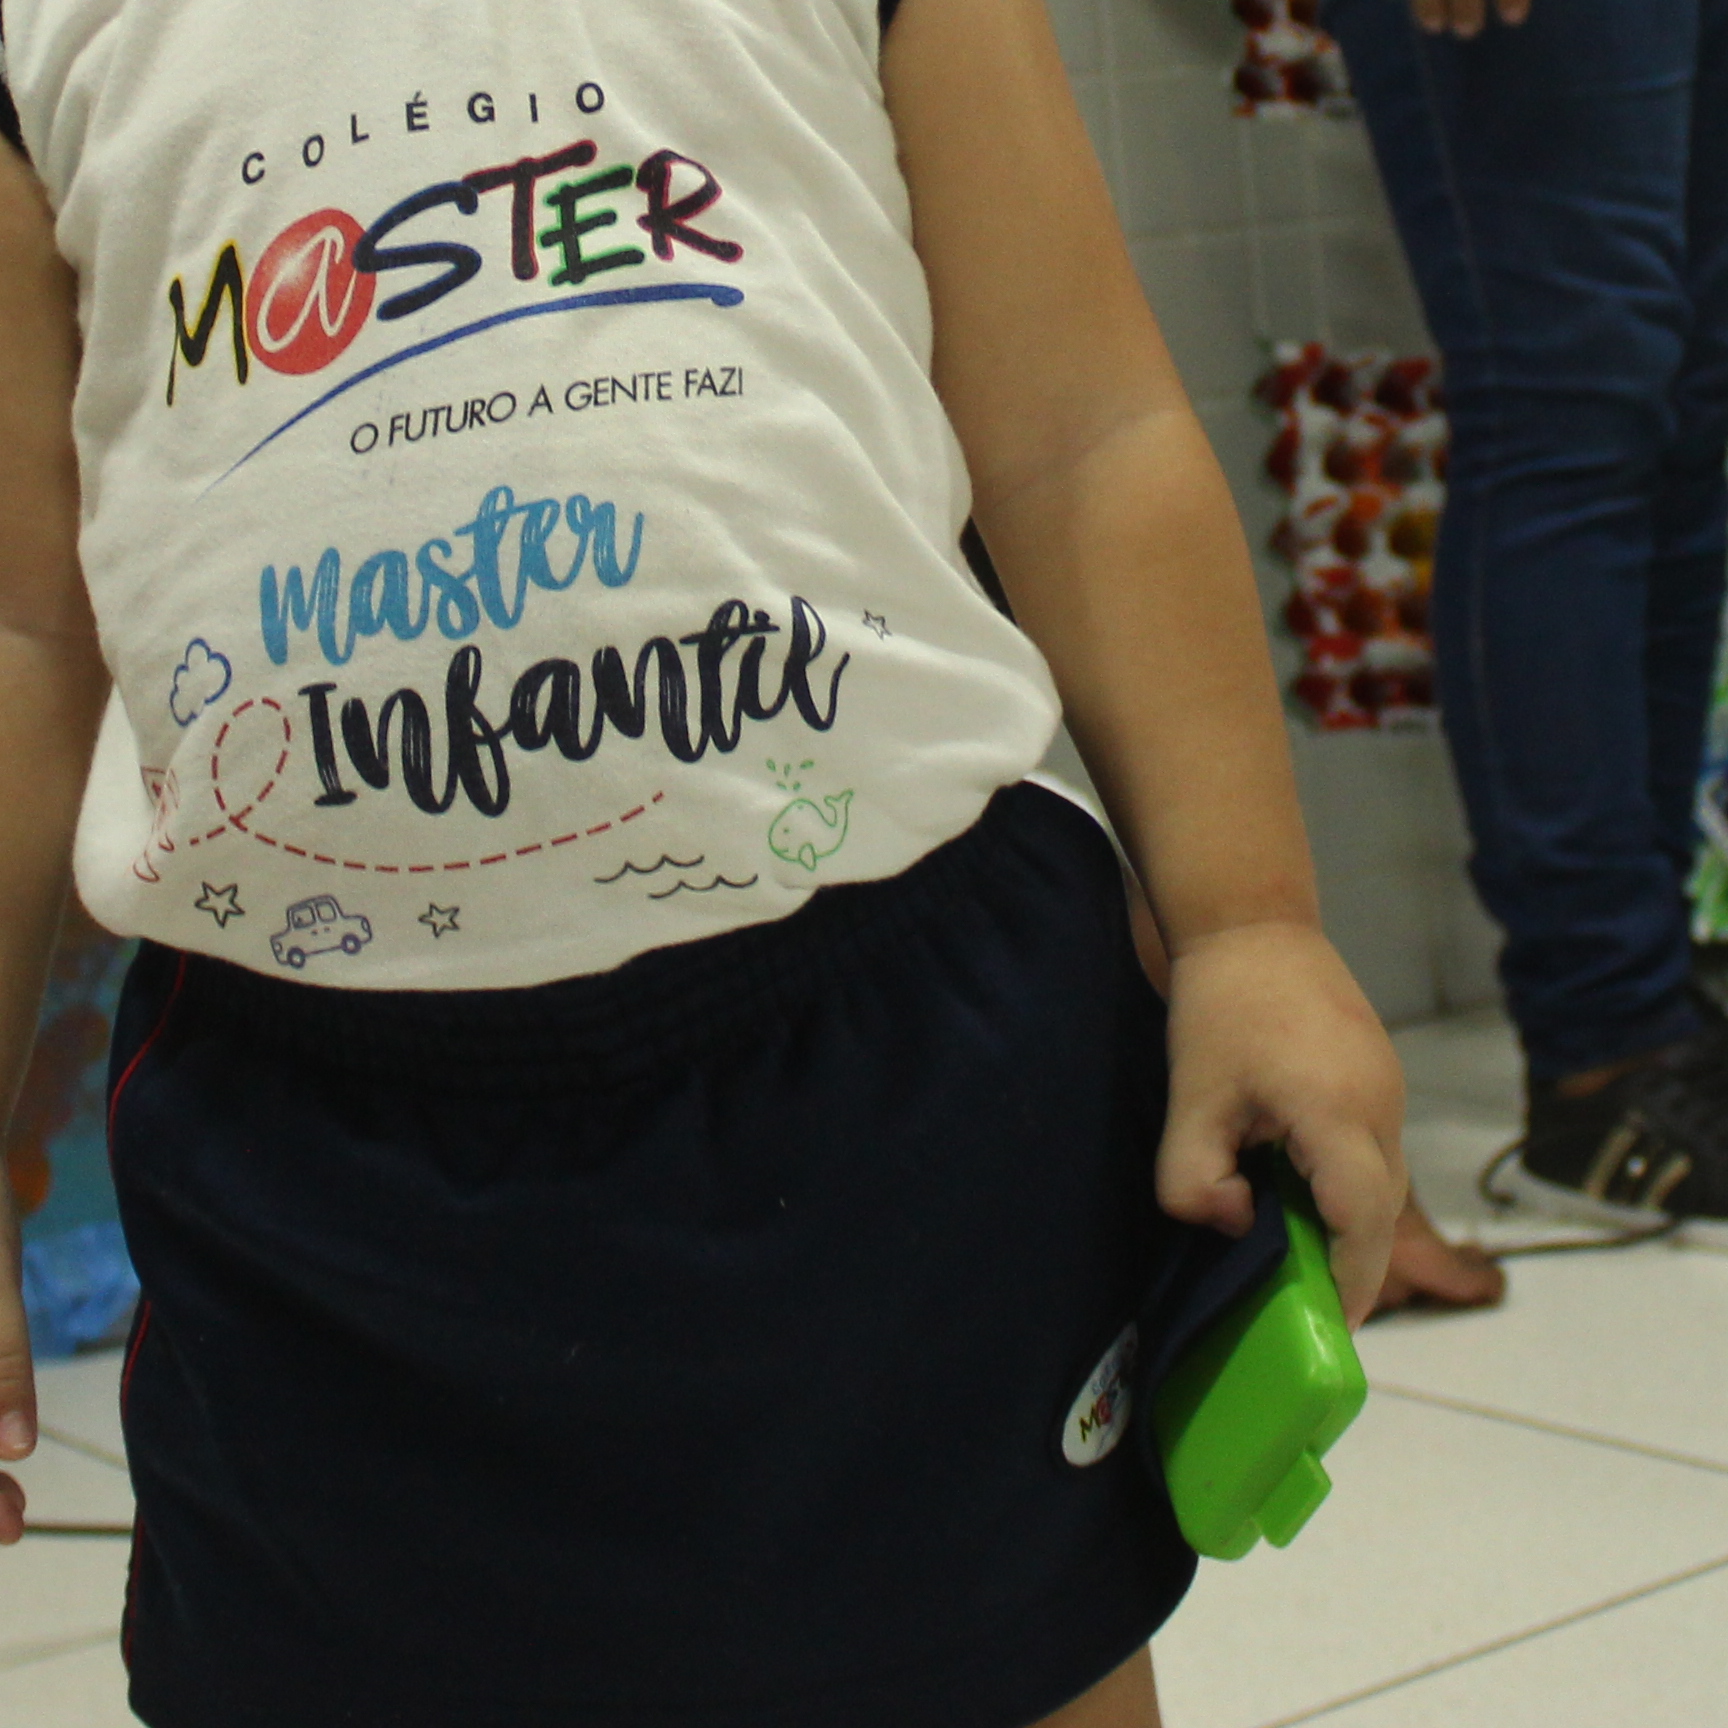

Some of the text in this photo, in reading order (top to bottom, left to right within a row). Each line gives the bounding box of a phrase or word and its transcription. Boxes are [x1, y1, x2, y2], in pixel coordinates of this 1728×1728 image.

[241, 81, 604, 184] COLÉGIO
[351, 423, 379, 454] O
[388, 391, 516, 447] FUTURO
[527, 384, 553, 417] A
[565, 371, 671, 411] GENTE
[259, 485, 644, 665] master
[298, 595, 850, 817] Infantil
